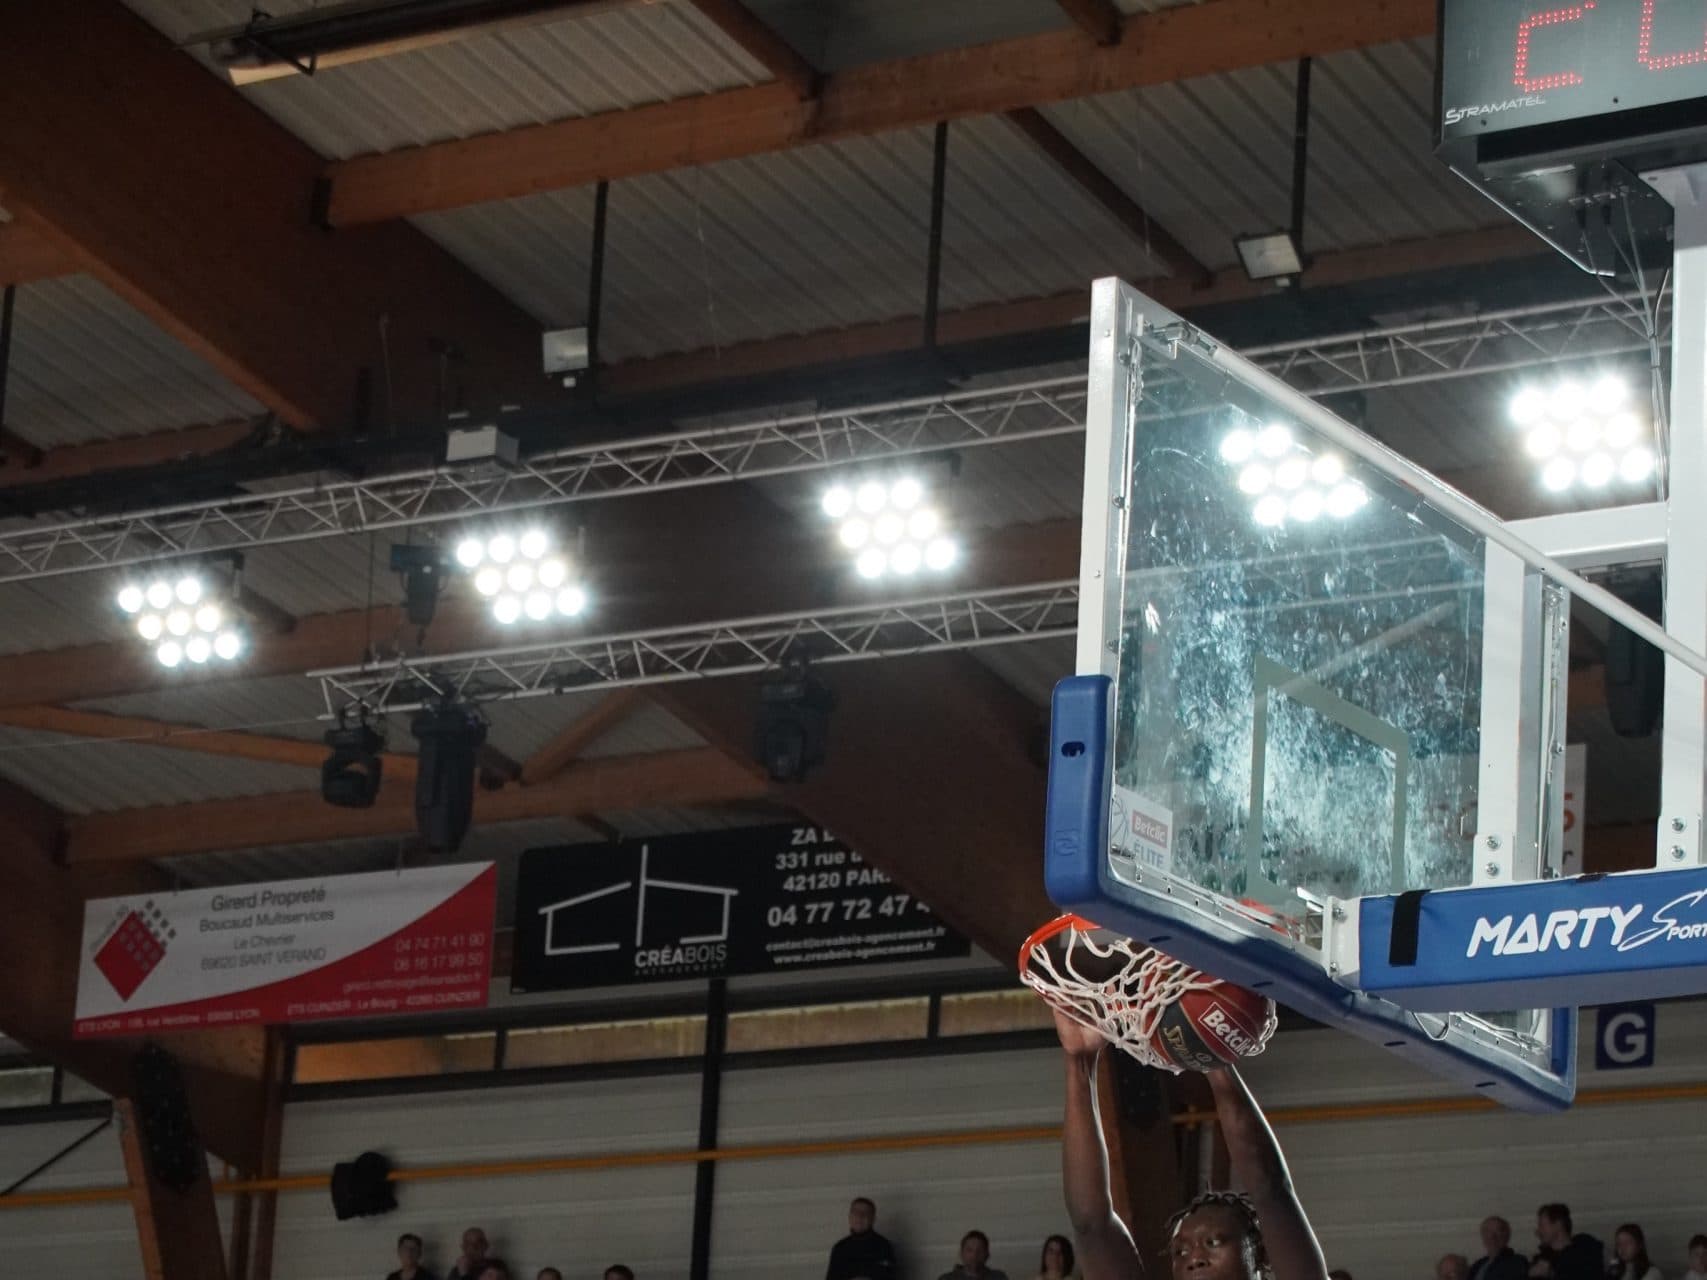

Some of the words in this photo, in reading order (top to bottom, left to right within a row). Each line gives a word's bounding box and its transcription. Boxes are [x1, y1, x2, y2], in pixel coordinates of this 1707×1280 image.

[1444, 95, 1546, 125] STRAMATEL
[791, 827, 818, 845] ZA
[1134, 814, 1166, 842] Betclic
[775, 851, 808, 870] 331
[815, 850, 846, 867] rue
[783, 871, 840, 892] 42120
[261, 884, 326, 908] Propreté
[256, 910, 335, 926] Multiservices
[767, 904, 797, 927] 04
[805, 901, 835, 925] 77
[842, 897, 872, 921] 72
[878, 895, 910, 917] 47
[1466, 903, 1643, 958] MARTY
[1617, 887, 1707, 952] SPORT
[240, 951, 273, 967] SAINT
[1603, 1013, 1648, 1062] G
